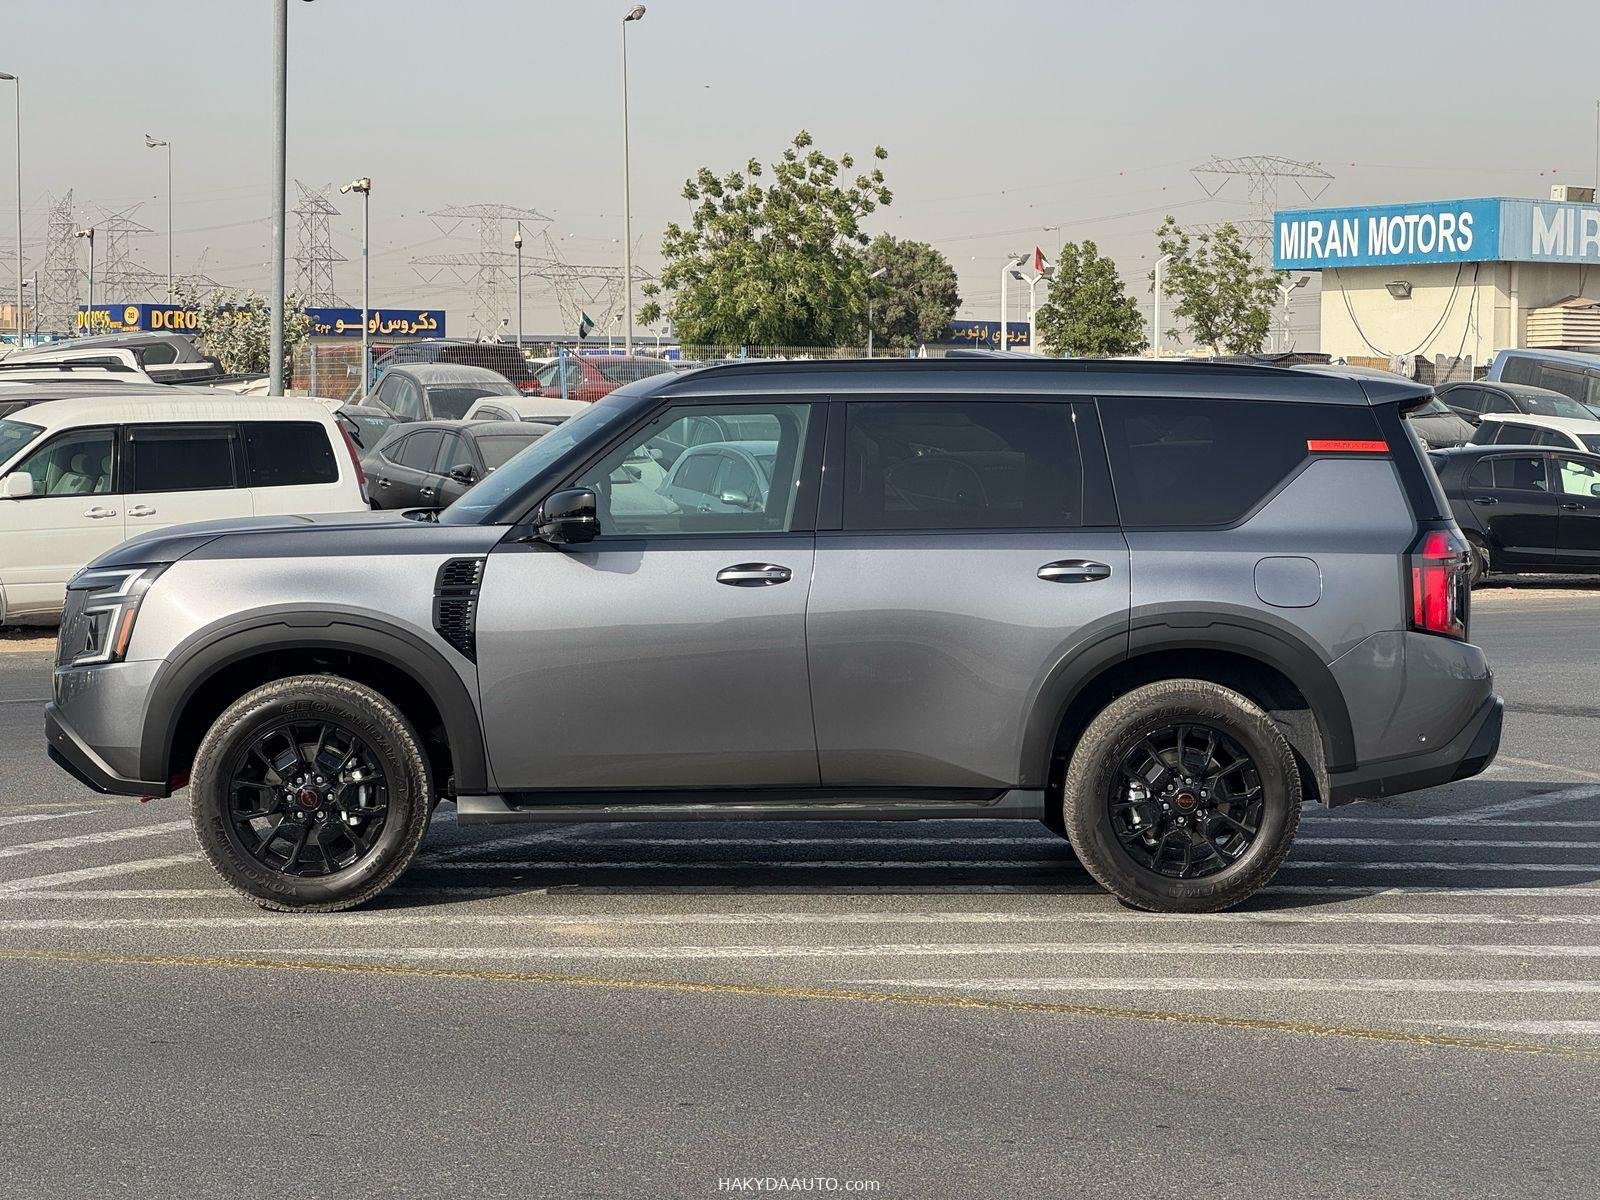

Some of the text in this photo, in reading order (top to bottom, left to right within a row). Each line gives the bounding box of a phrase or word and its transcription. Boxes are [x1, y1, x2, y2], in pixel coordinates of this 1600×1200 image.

[1280, 212, 1474, 260] MIRAN MOTORS
[151, 309, 200, 329] DCRO
